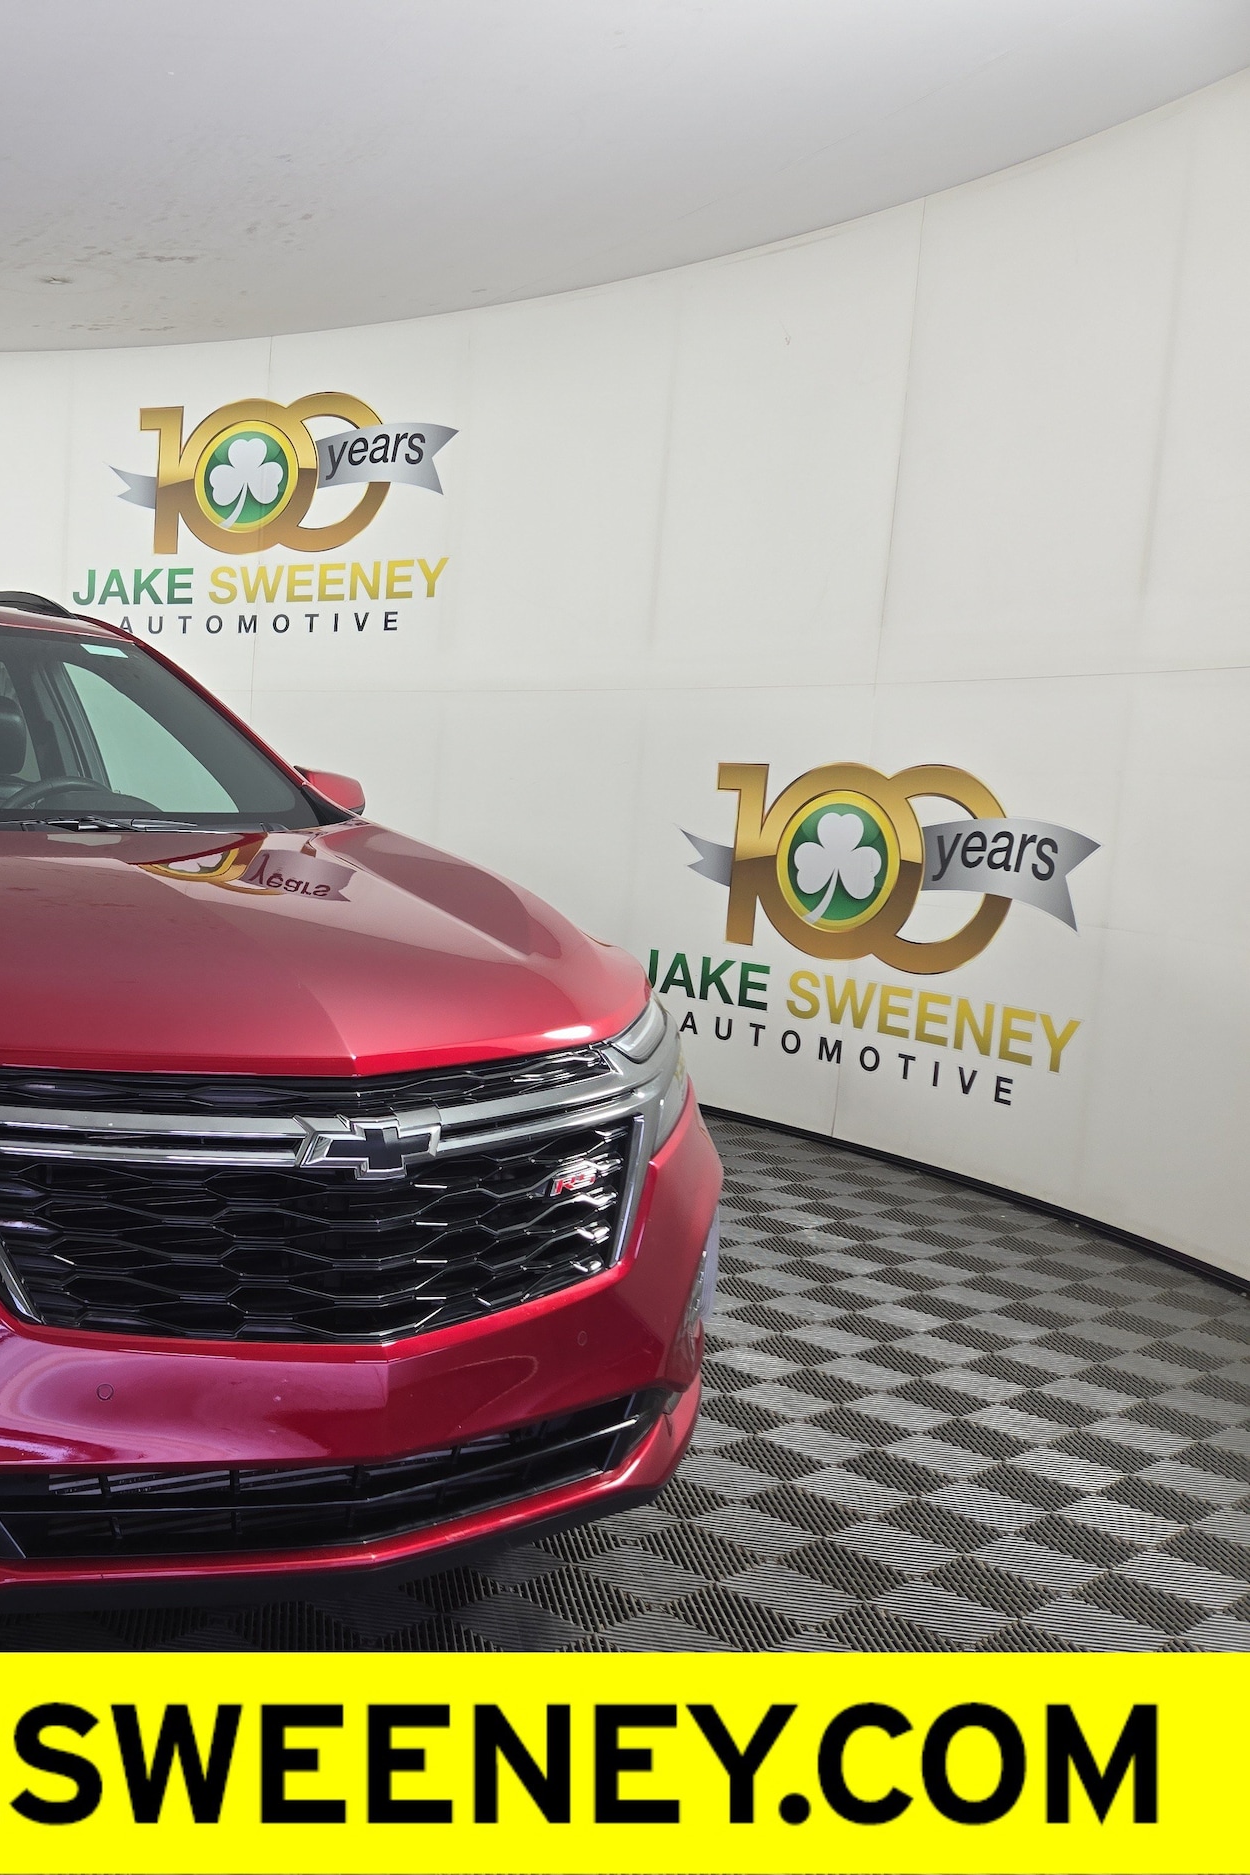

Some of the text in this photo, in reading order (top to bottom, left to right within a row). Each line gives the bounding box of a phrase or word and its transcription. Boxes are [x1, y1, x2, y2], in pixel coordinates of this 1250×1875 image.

[139, 391, 426, 555] 100 years
[72, 557, 450, 606] JAKE SWEENEY
[119, 611, 399, 635] AUTOMOTIVE
[716, 761, 1059, 975] 100 years
[679, 1011, 1014, 1106] AUTOMOTIVE
[786, 970, 1082, 1073] SWEENEY
